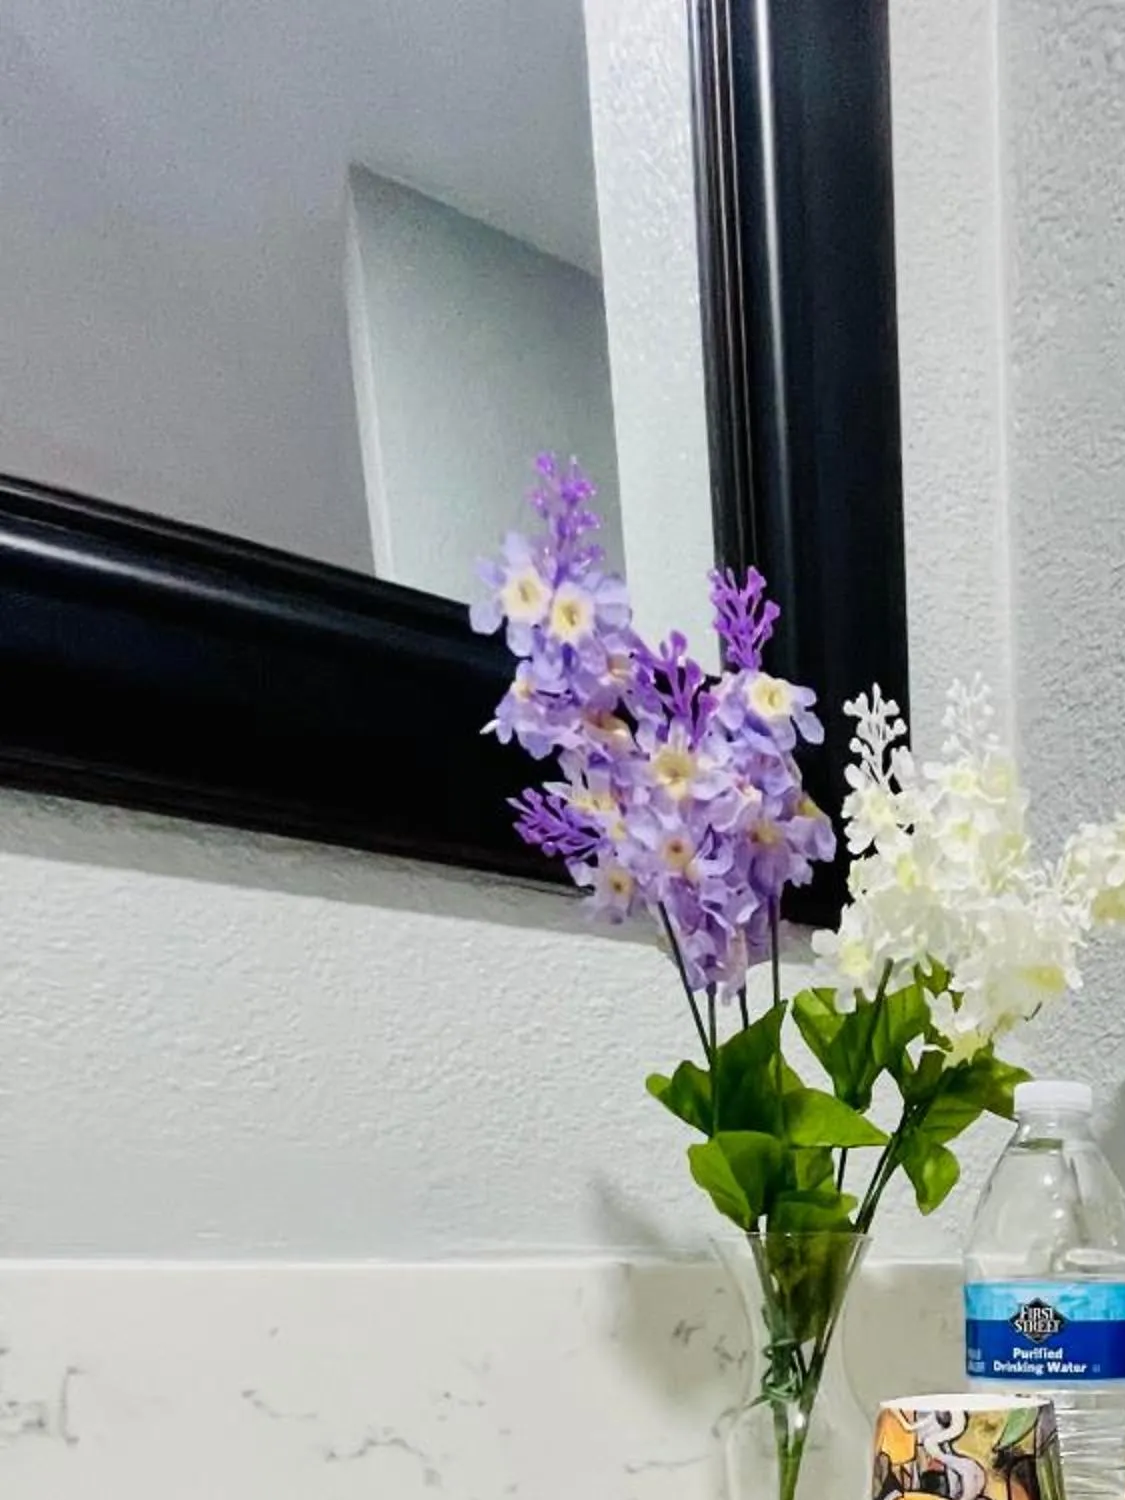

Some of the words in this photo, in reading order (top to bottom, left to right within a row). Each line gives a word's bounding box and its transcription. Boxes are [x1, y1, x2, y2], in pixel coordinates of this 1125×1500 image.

[1019, 1306, 1054, 1320] FIRST
[1014, 1320, 1060, 1333] STREET
[1012, 1347, 1063, 1360] Purified
[993, 1360, 1043, 1375] Drinking
[1046, 1362, 1088, 1373] Water
